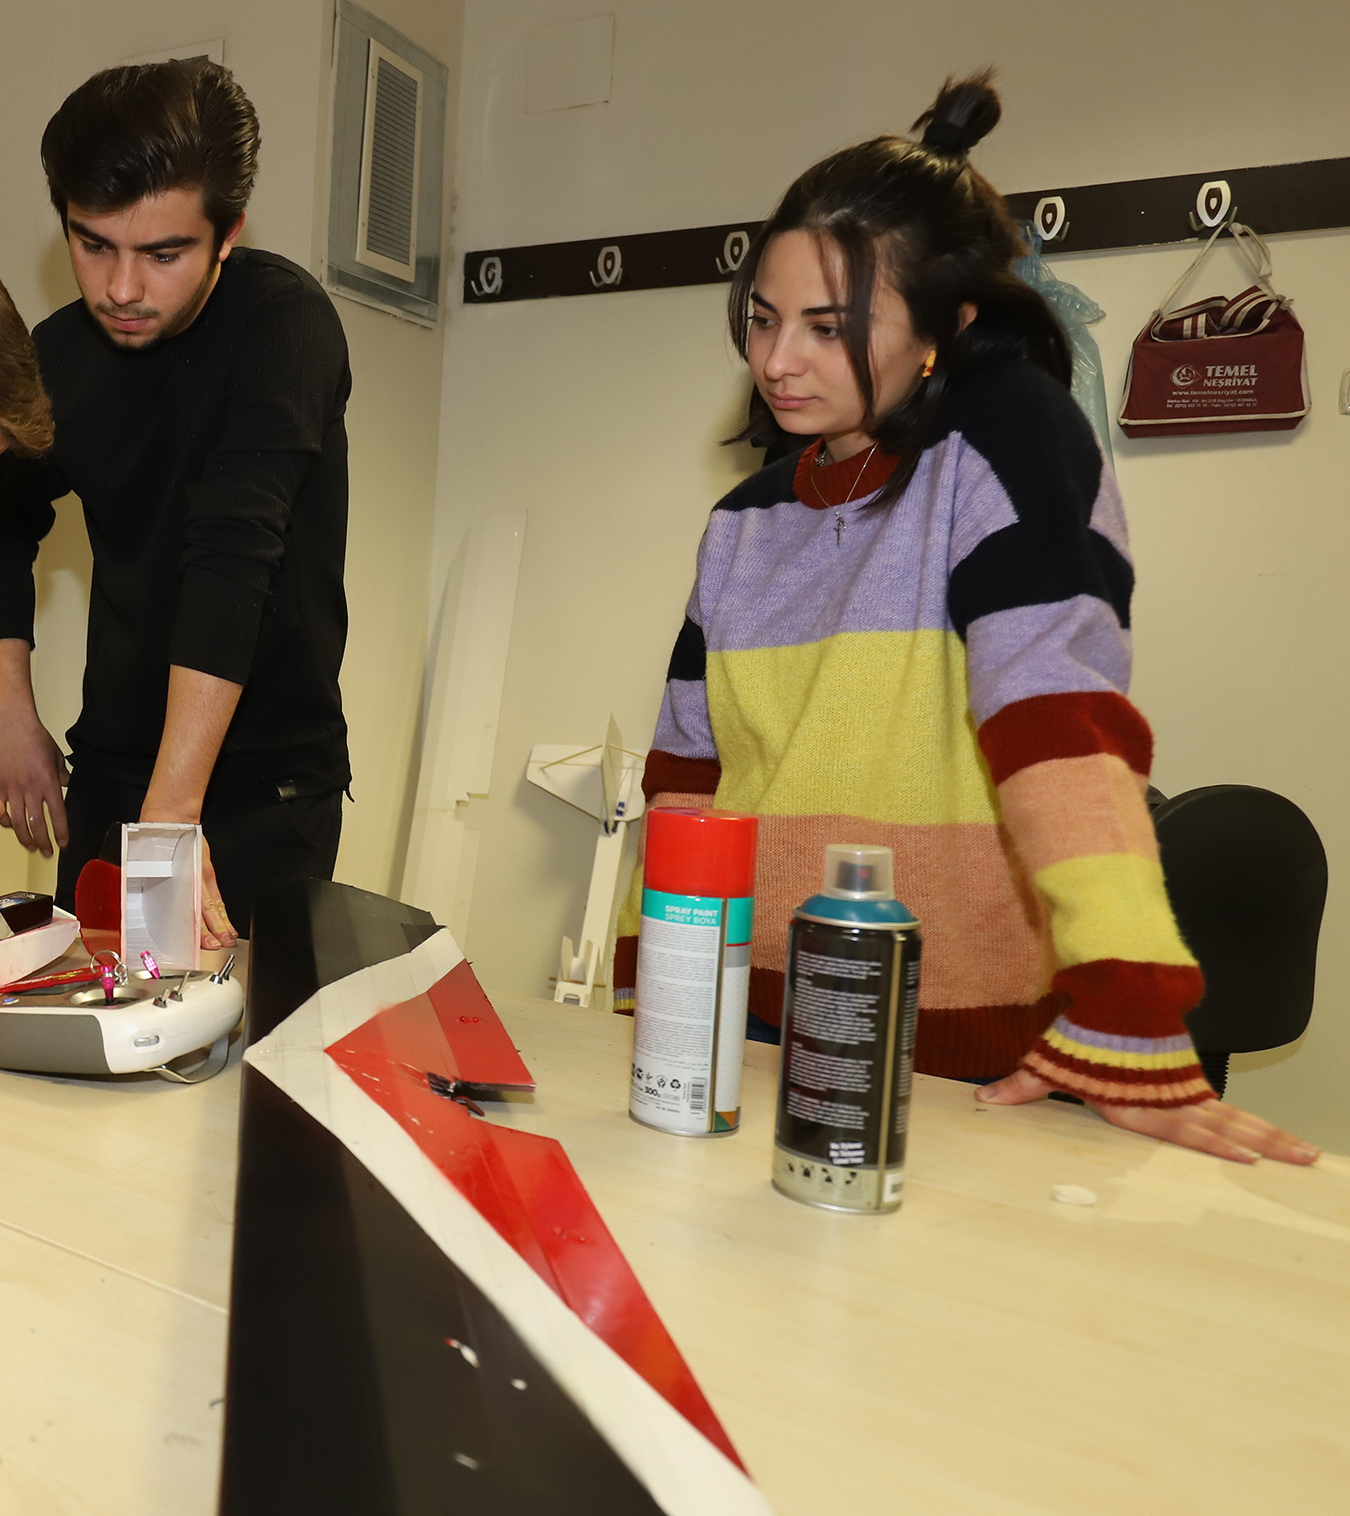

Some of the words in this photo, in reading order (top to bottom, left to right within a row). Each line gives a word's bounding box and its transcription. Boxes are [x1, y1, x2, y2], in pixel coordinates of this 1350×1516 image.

[1205, 365, 1258, 377] TEMEL
[1203, 377, 1258, 388] NEŞRİYAT
[665, 905, 692, 915] SPRAY
[693, 908, 719, 917] PAINT
[665, 912, 692, 923] SPREY
[693, 916, 717, 925] BOYA
